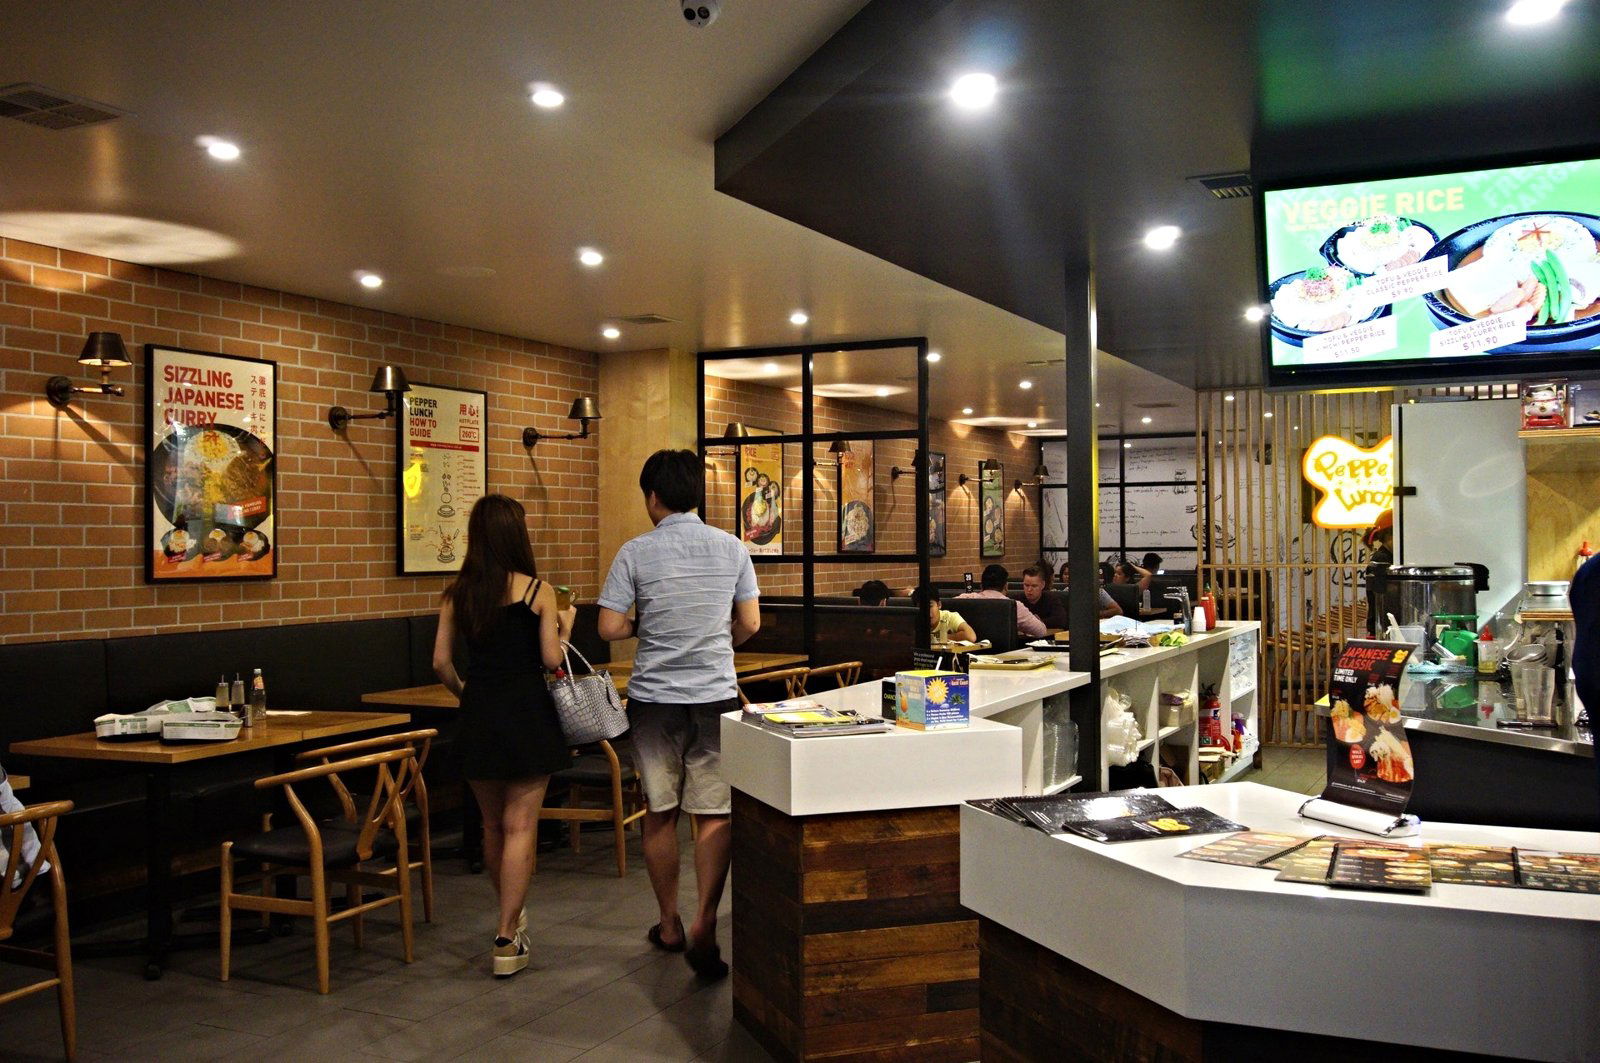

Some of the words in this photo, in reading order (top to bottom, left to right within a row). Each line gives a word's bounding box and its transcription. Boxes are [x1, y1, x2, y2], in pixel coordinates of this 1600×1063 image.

[1283, 194, 1388, 224] VEGGIE
[1396, 186, 1465, 215] RICE
[1463, 336, 1498, 351] $11.90
[164, 364, 233, 389] SIZZLING
[163, 386, 245, 411] JAPANESE
[409, 397, 438, 409] PEPPER
[164, 407, 217, 431] CURRY
[409, 407, 434, 418] LUNCH
[409, 418, 427, 428] HOW
[428, 420, 437, 428] TO
[409, 428, 432, 438] GUIDE
[1344, 647, 1391, 660] JAPANESE
[1338, 657, 1375, 671] CLASSIC
